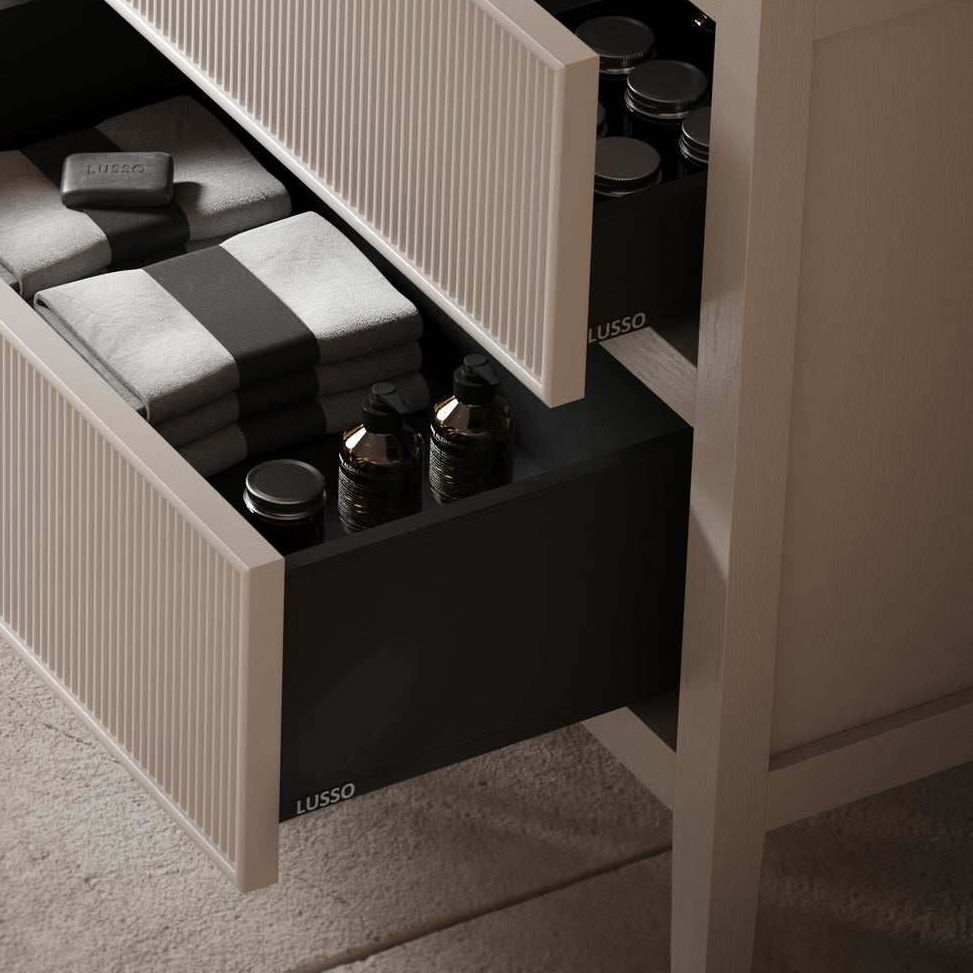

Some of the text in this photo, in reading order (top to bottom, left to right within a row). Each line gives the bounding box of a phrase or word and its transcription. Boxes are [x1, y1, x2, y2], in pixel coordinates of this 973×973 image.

[87, 164, 147, 175] LUSSO
[588, 312, 646, 343] LUSSO
[296, 782, 356, 815] LUSSO
